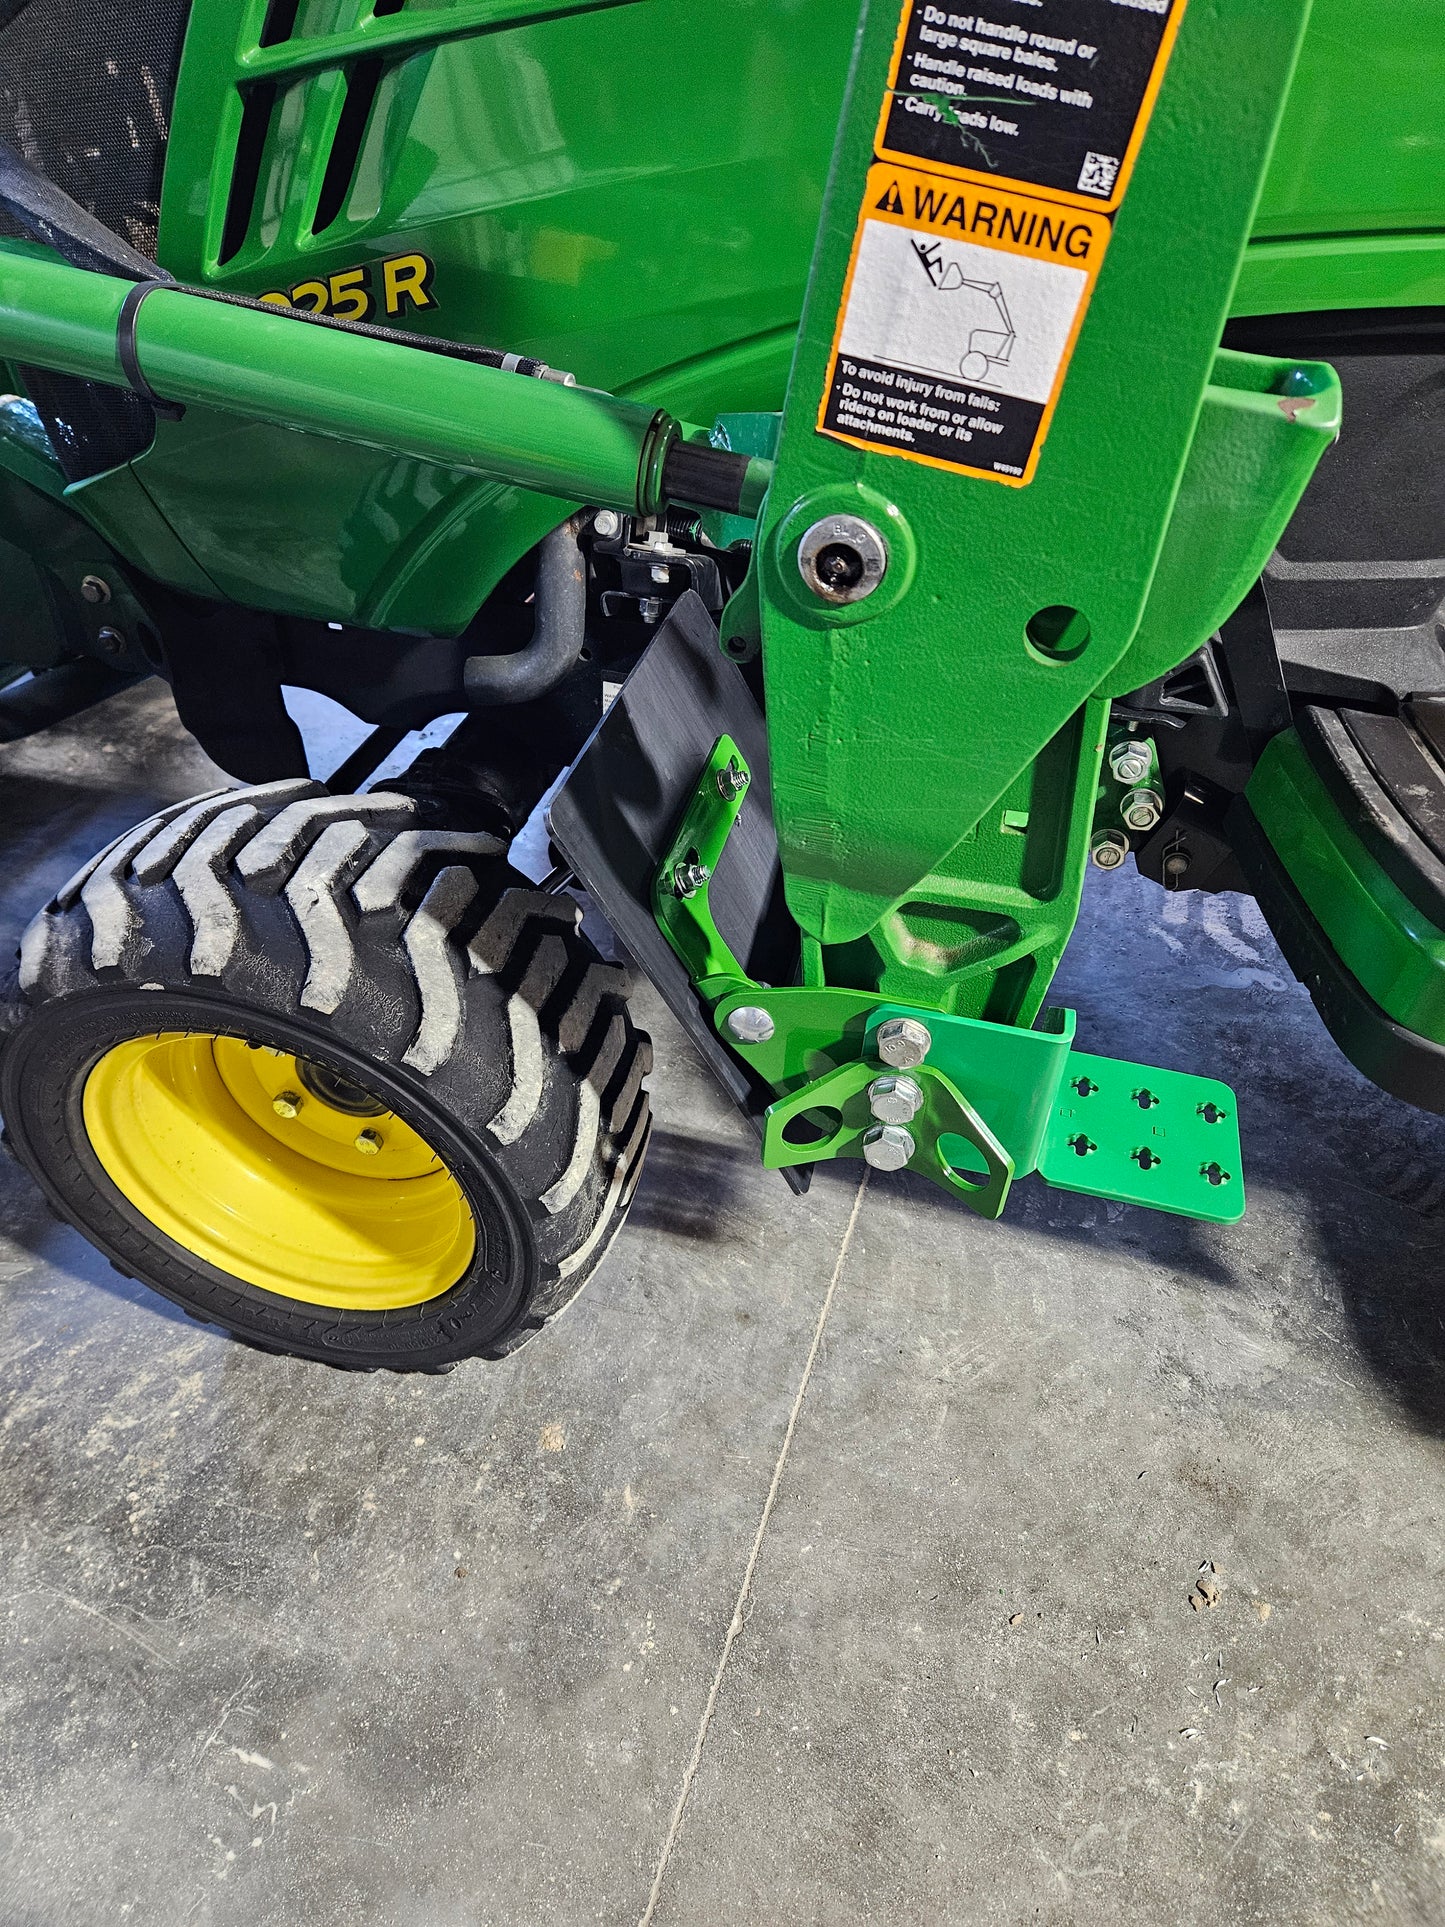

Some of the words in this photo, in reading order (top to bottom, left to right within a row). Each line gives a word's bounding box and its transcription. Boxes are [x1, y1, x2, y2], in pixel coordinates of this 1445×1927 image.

[919, 25, 959, 49] large
[959, 36, 1012, 61] square
[1013, 46, 1058, 72] bales.
[923, 6, 947, 26] Do
[948, 13, 974, 32] not
[975, 18, 1028, 43] handle
[1029, 31, 1076, 55] round
[1077, 43, 1098, 60] or
[910, 73, 967, 97] caution.
[914, 52, 966, 77] Handle
[967, 64, 1014, 88] raised
[1015, 76, 1058, 100] loads
[1060, 88, 1094, 109] with
[905, 96, 943, 122] Carry
[990, 113, 1020, 137] low.
[913, 186, 1093, 260] WARNING
[841, 360, 857, 376] To
[858, 366, 894, 387] avoid
[895, 375, 934, 397] injury
[934, 384, 966, 403] from
[967, 392, 1001, 412] falls:
[842, 383, 862, 400] Do
[863, 389, 885, 405] not
[886, 393, 918, 414] work
[919, 401, 950, 421] from
[951, 411, 967, 425] or
[968, 413, 1004, 435] allow
[836, 413, 915, 443] attachments.
[839, 400, 876, 420] riders
[877, 409, 895, 424] on
[896, 412, 937, 433] loader
[938, 423, 954, 437] or
[955, 425, 973, 443] its
